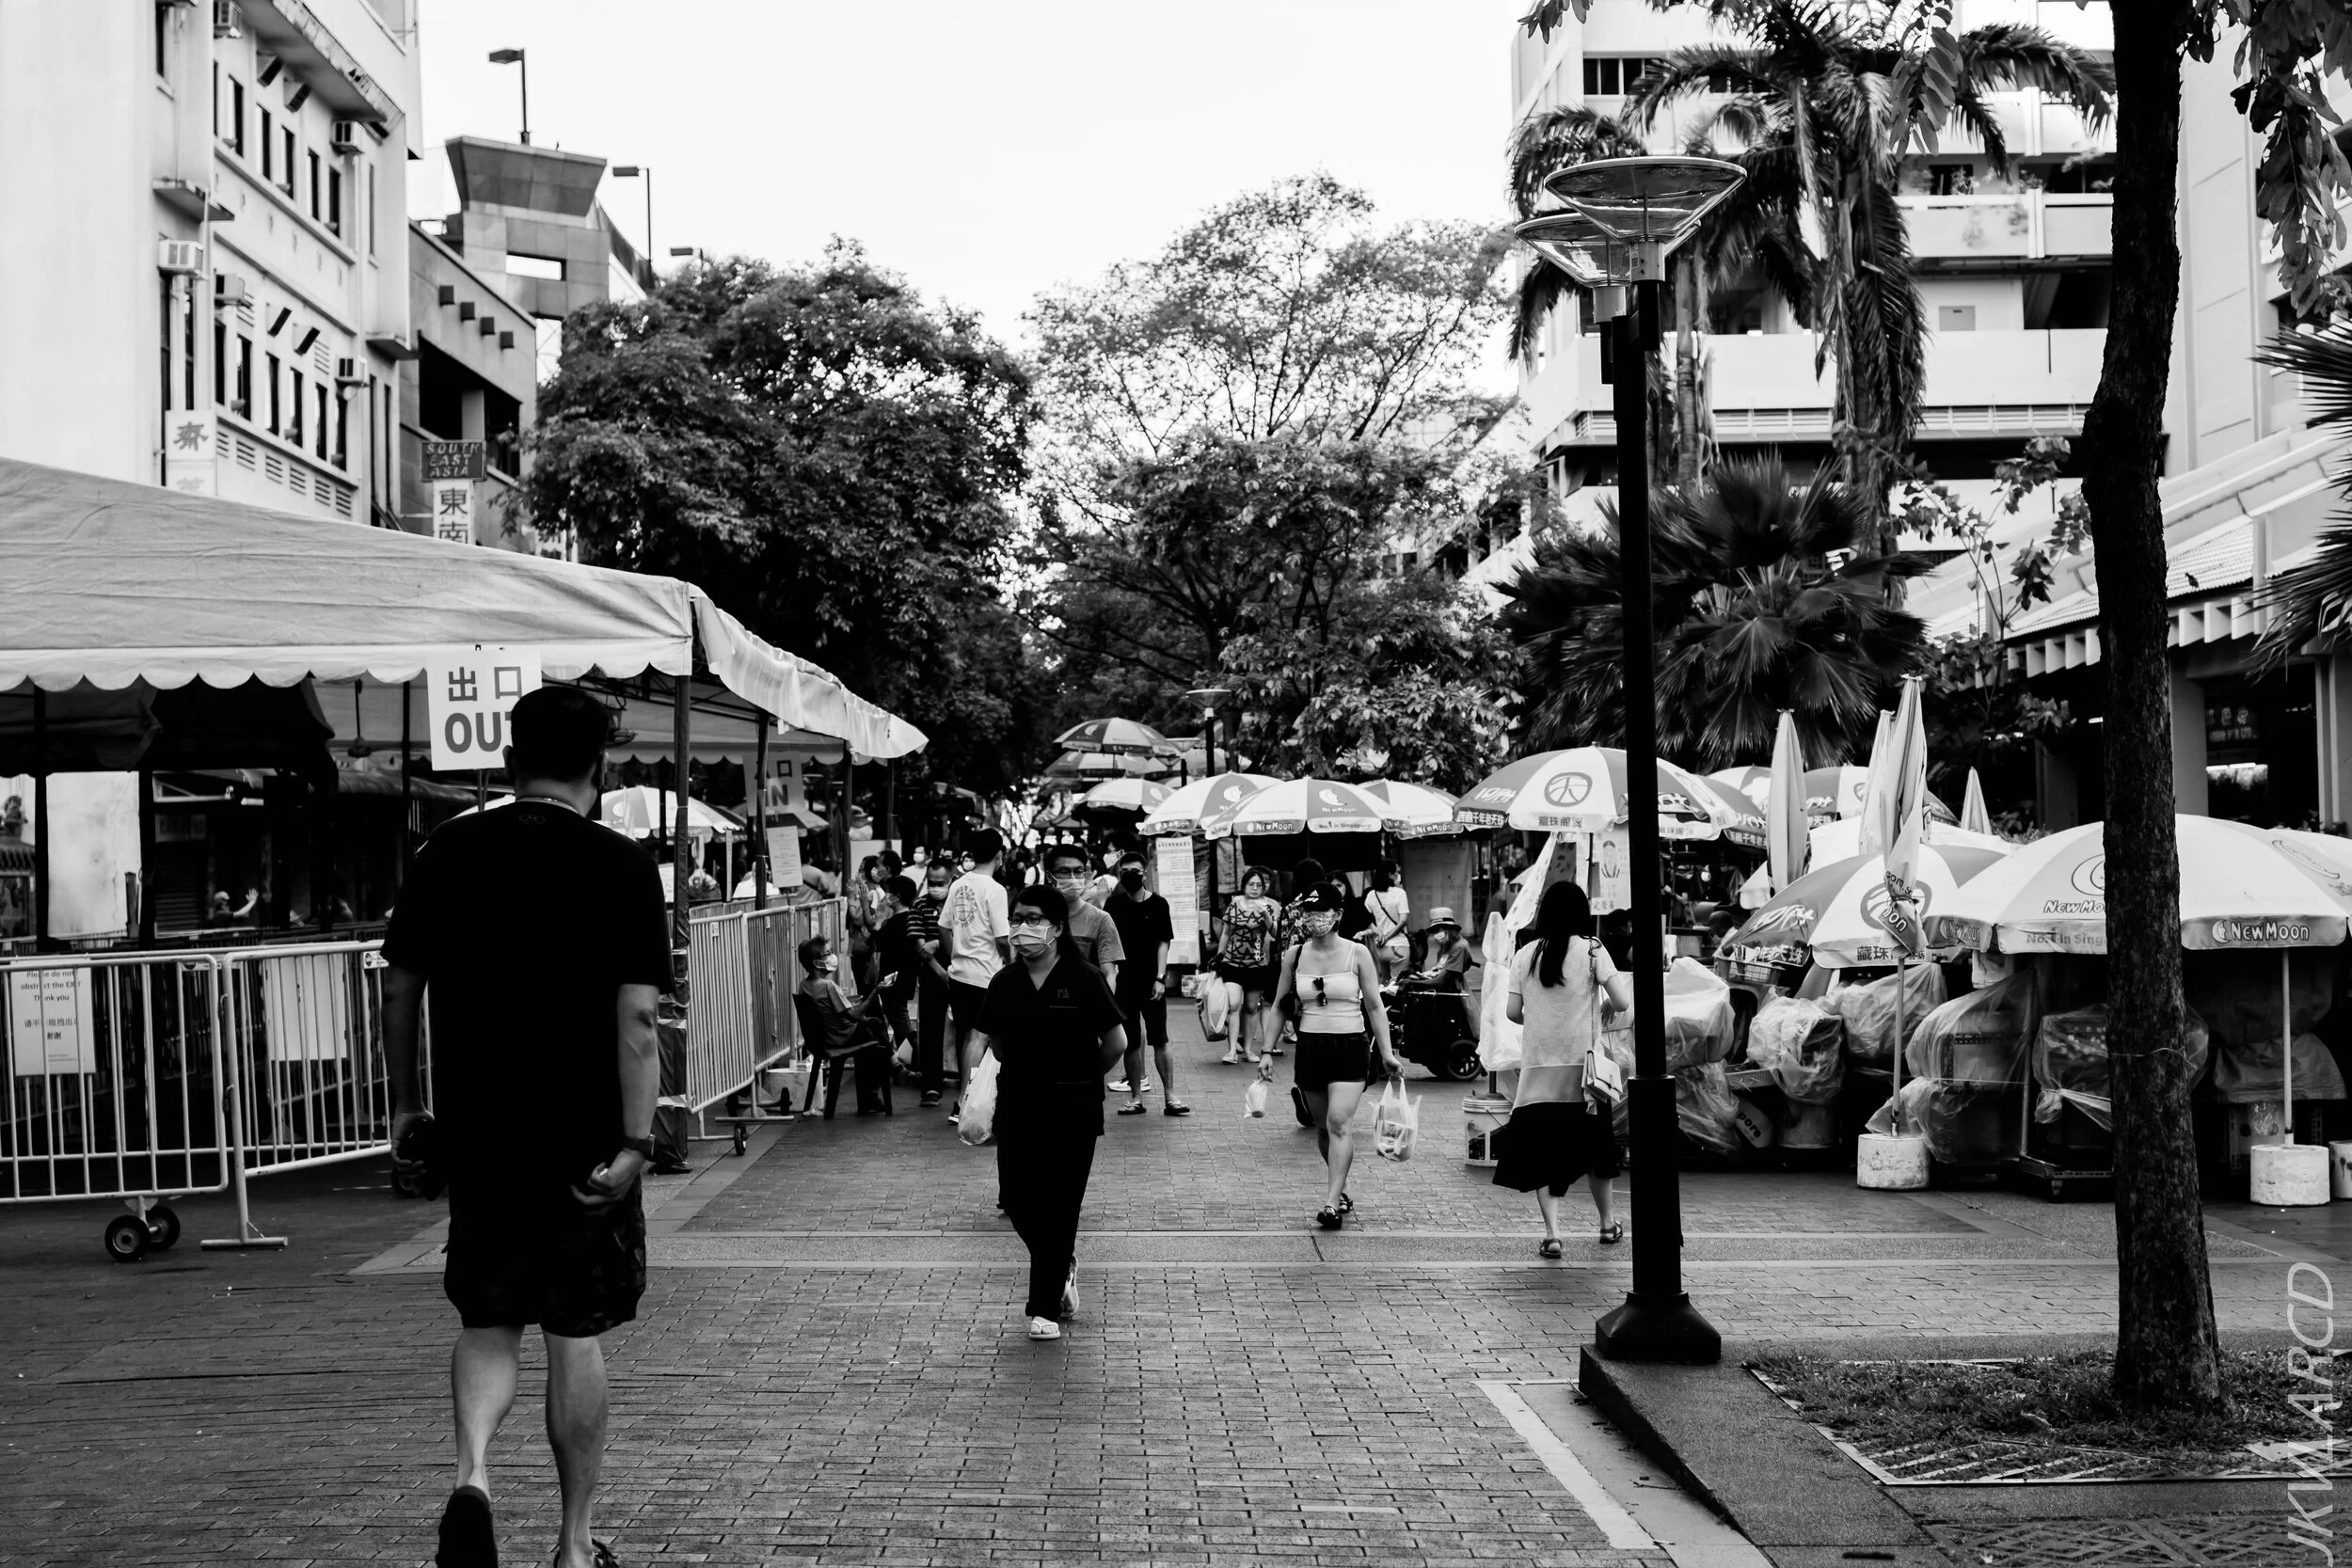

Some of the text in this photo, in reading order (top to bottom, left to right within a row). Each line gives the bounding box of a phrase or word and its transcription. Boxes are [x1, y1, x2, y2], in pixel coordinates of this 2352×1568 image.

[426, 443, 480, 454] SOUTH
[429, 453, 471, 467] EAST
[430, 466, 469, 477] ASIA
[448, 666, 523, 702] 出口
[444, 711, 513, 753] OU
[1256, 821, 1293, 832] NewMoon
[1416, 822, 1453, 834] NewMoon
[2043, 899, 2106, 913] NewMo
[2230, 920, 2310, 942] NewMoon
[2074, 933, 2107, 947] Sing
[21, 982, 50, 990] obstrct
[1736, 1112, 1761, 1138] pore
